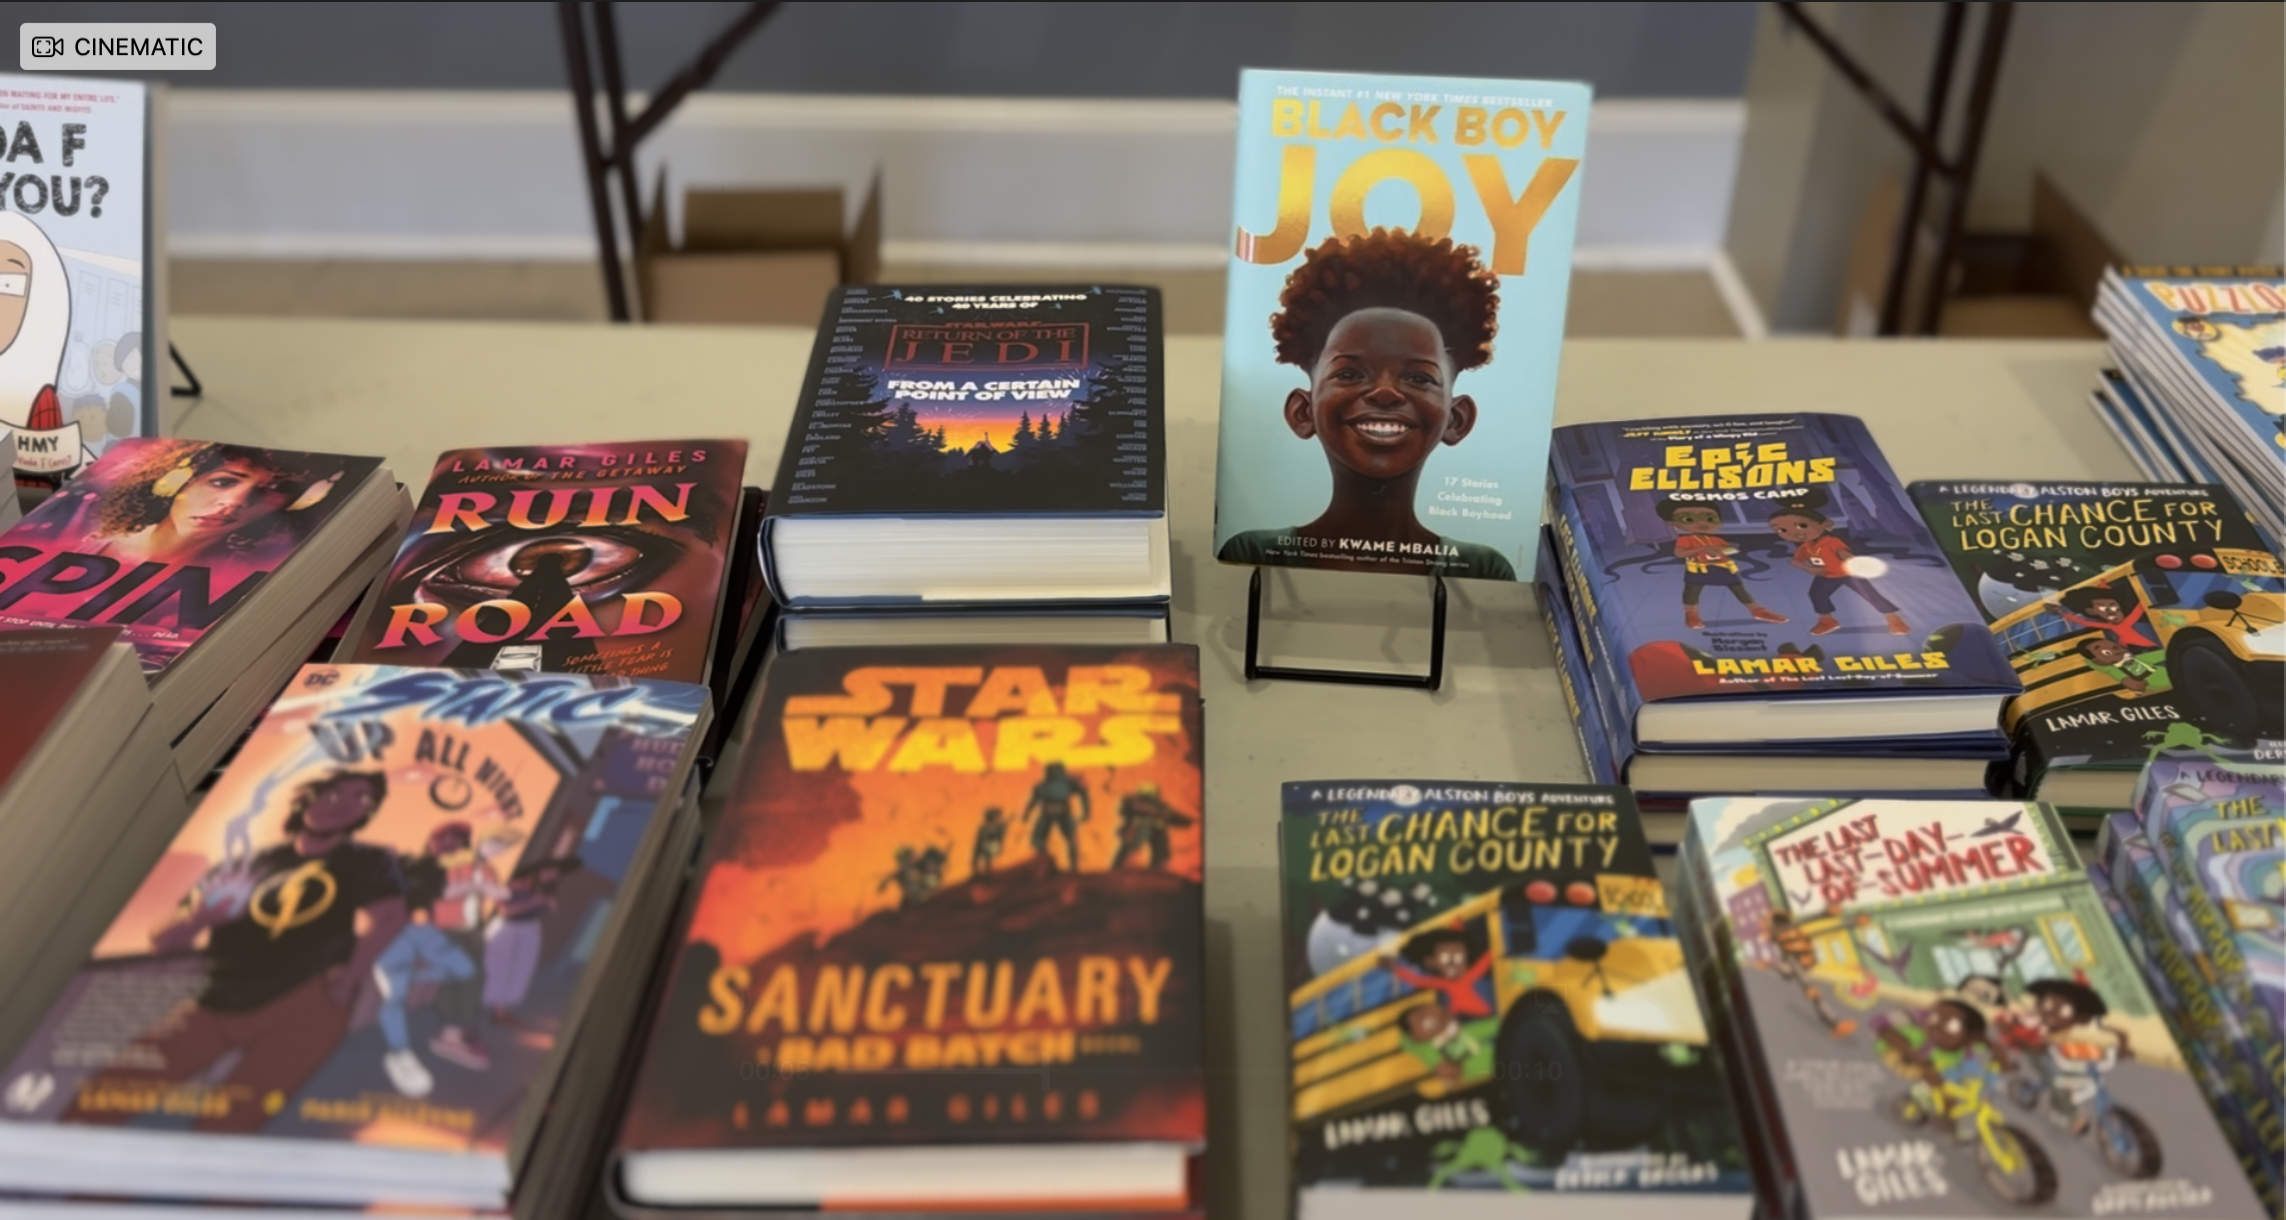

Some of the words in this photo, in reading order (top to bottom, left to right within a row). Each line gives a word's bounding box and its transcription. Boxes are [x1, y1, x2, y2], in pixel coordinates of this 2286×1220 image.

[1277, 86, 1298, 97] THE
[1271, 97, 1442, 144] BLACK
[1454, 106, 1567, 150] BOY
[62, 123, 87, 167] F
[1235, 144, 1580, 275] JOY
[989, 294, 1087, 302] CELEBRATING
[902, 330, 992, 341] RETURN
[996, 330, 1028, 340] OF
[1031, 328, 1075, 338] THE
[894, 340, 1074, 364] JEDI
[887, 380, 954, 390] FROM
[960, 382, 978, 390] A
[984, 379, 1080, 390] CERTAIN
[895, 391, 970, 399] POINT
[974, 391, 1007, 399] OF
[1011, 389, 1072, 399] VIEW
[453, 456, 576, 473] LAMAR
[602, 450, 706, 467] GILES
[458, 474, 518, 483] AUTHOR
[551, 470, 586, 480] THE
[597, 465, 686, 478] GETAWAY
[1461, 478, 1498, 489] Stories
[1437, 491, 1502, 506] Celebrating
[1669, 492, 1750, 501] COSMOS
[1754, 488, 1810, 499] CAMP
[1940, 485, 1948, 493] A
[2041, 487, 2097, 497] ALSTON
[2102, 487, 2138, 498] BOYS
[423, 484, 697, 535] RUIN
[1429, 506, 1457, 516] Black
[1462, 508, 1512, 520] Boyhood
[1952, 500, 1992, 511] THE
[2010, 499, 2157, 526] CHANCE
[2165, 502, 2217, 517] FOR
[1953, 511, 2003, 527] LAST
[1278, 536, 1318, 547] EDITED
[1321, 539, 1335, 548] BY
[1339, 539, 1395, 551] KWAME
[1399, 543, 1460, 557] MBALIA
[1961, 526, 2067, 551] LOGAN
[2081, 519, 2222, 548] COUNTY
[374, 591, 683, 649] ROAD
[562, 644, 645, 666] SOMETIMES
[651, 641, 660, 651] A
[618, 653, 656, 667] FEAR
[660, 648, 674, 658] IS
[1693, 657, 1823, 675] LAMAR
[1834, 652, 1950, 671] GILES
[304, 669, 340, 687] DC
[783, 665, 1182, 716] STAR
[2045, 710, 2118, 732] LAMAR
[2120, 705, 2181, 722] GILES
[307, 719, 395, 764] UP
[780, 714, 1182, 773] WARS
[415, 728, 471, 772] ALL
[474, 757, 524, 820] NIGHT
[1424, 789, 1488, 801] ALSTON
[1494, 791, 1535, 803] BOYS
[2216, 795, 2266, 818] THE
[1311, 824, 1368, 848] LAST
[1319, 809, 1363, 824] THE
[1377, 806, 1547, 844] CHANCE
[1557, 812, 1617, 833] FOR
[1774, 839, 1823, 865] THE
[1824, 814, 1879, 851] LAST
[2213, 823, 2278, 852] LAST
[1311, 843, 1437, 881] LOGAN
[1449, 836, 1618, 874] COUNTY
[699, 957, 1172, 1034] SANCTUARY
[776, 1036, 894, 1071] BAD
[904, 1029, 1076, 1067] BATCH
